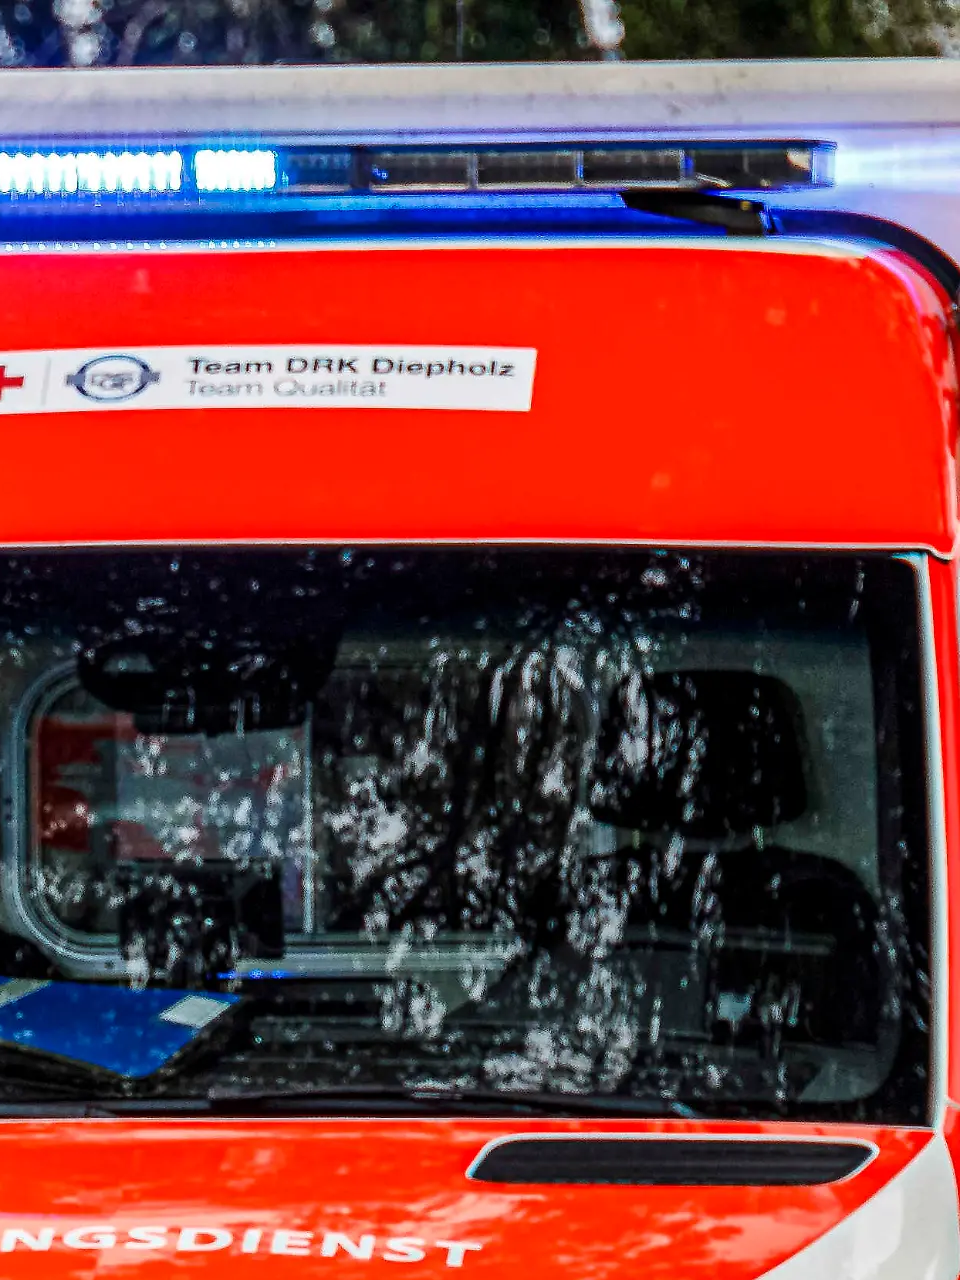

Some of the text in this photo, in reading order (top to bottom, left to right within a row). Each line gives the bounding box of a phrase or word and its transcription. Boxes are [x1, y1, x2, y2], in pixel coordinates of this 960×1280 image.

[189, 356, 516, 379] Team DRK Diepholz
[185, 379, 264, 397] Team
